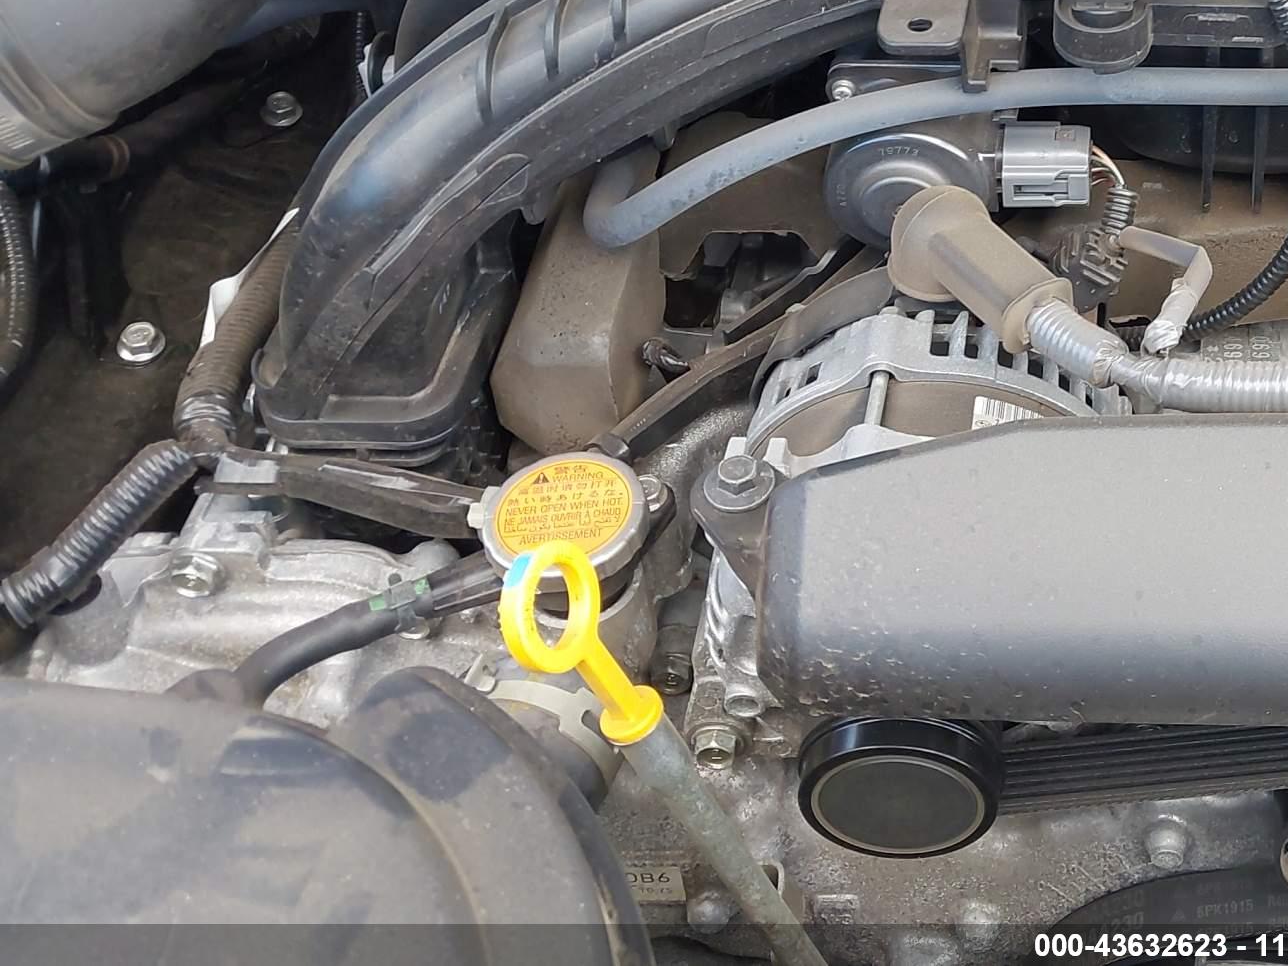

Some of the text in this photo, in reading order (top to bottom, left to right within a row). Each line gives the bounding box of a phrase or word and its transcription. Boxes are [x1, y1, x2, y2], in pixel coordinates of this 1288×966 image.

[552, 471, 604, 484] WARNING
[506, 505, 537, 517] NEVER
[540, 502, 568, 514] OPEN
[569, 498, 599, 510] WHEN
[519, 528, 602, 546] AVERTISSEMENT
